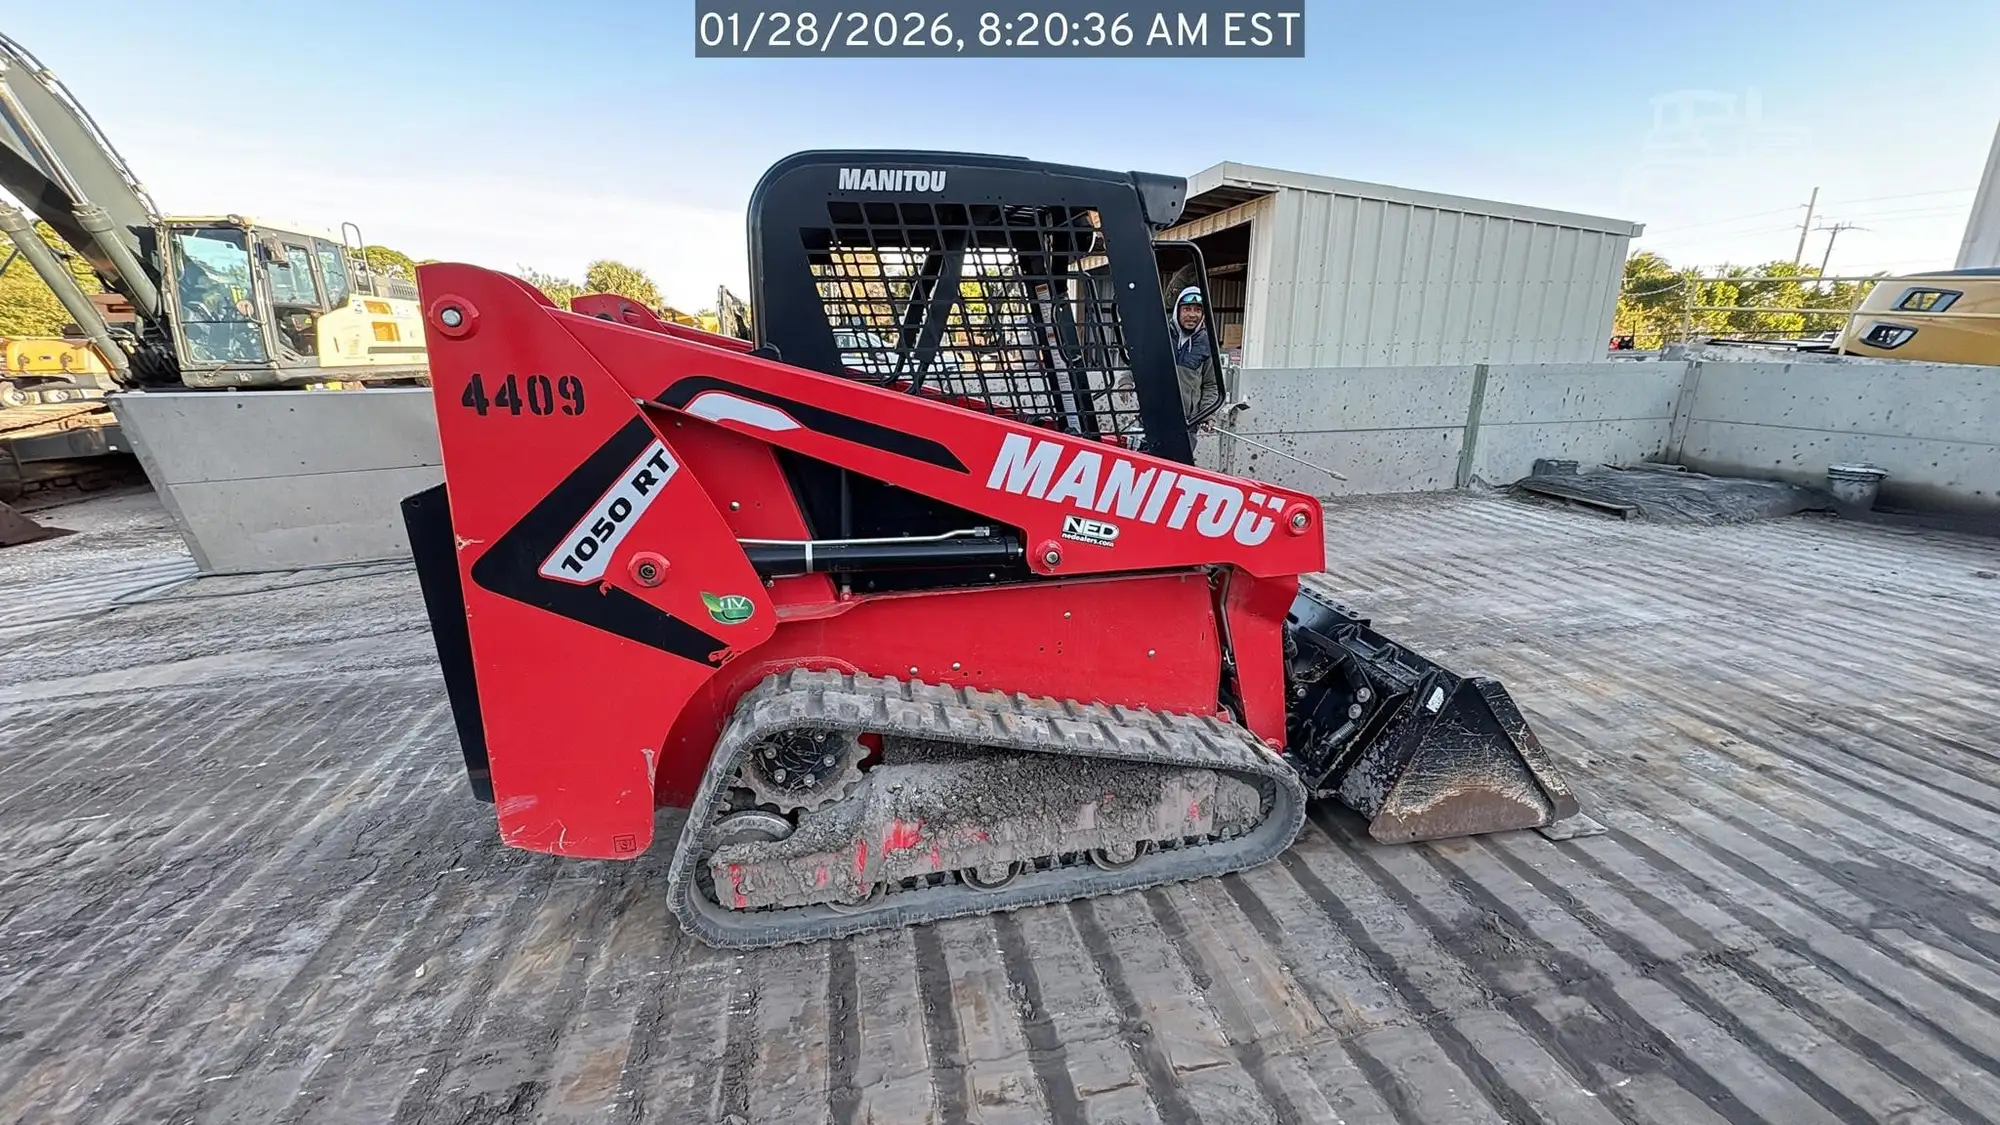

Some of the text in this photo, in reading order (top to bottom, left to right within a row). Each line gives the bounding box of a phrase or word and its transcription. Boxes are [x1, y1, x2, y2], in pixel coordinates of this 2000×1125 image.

[838, 168, 947, 192] MANITOU
[461, 373, 586, 416] 4409
[986, 432, 1286, 546] MANITOU
[561, 448, 670, 574] 1050 RT
[1062, 515, 1120, 540] NED
[1061, 533, 1114, 547] nedealers.com
